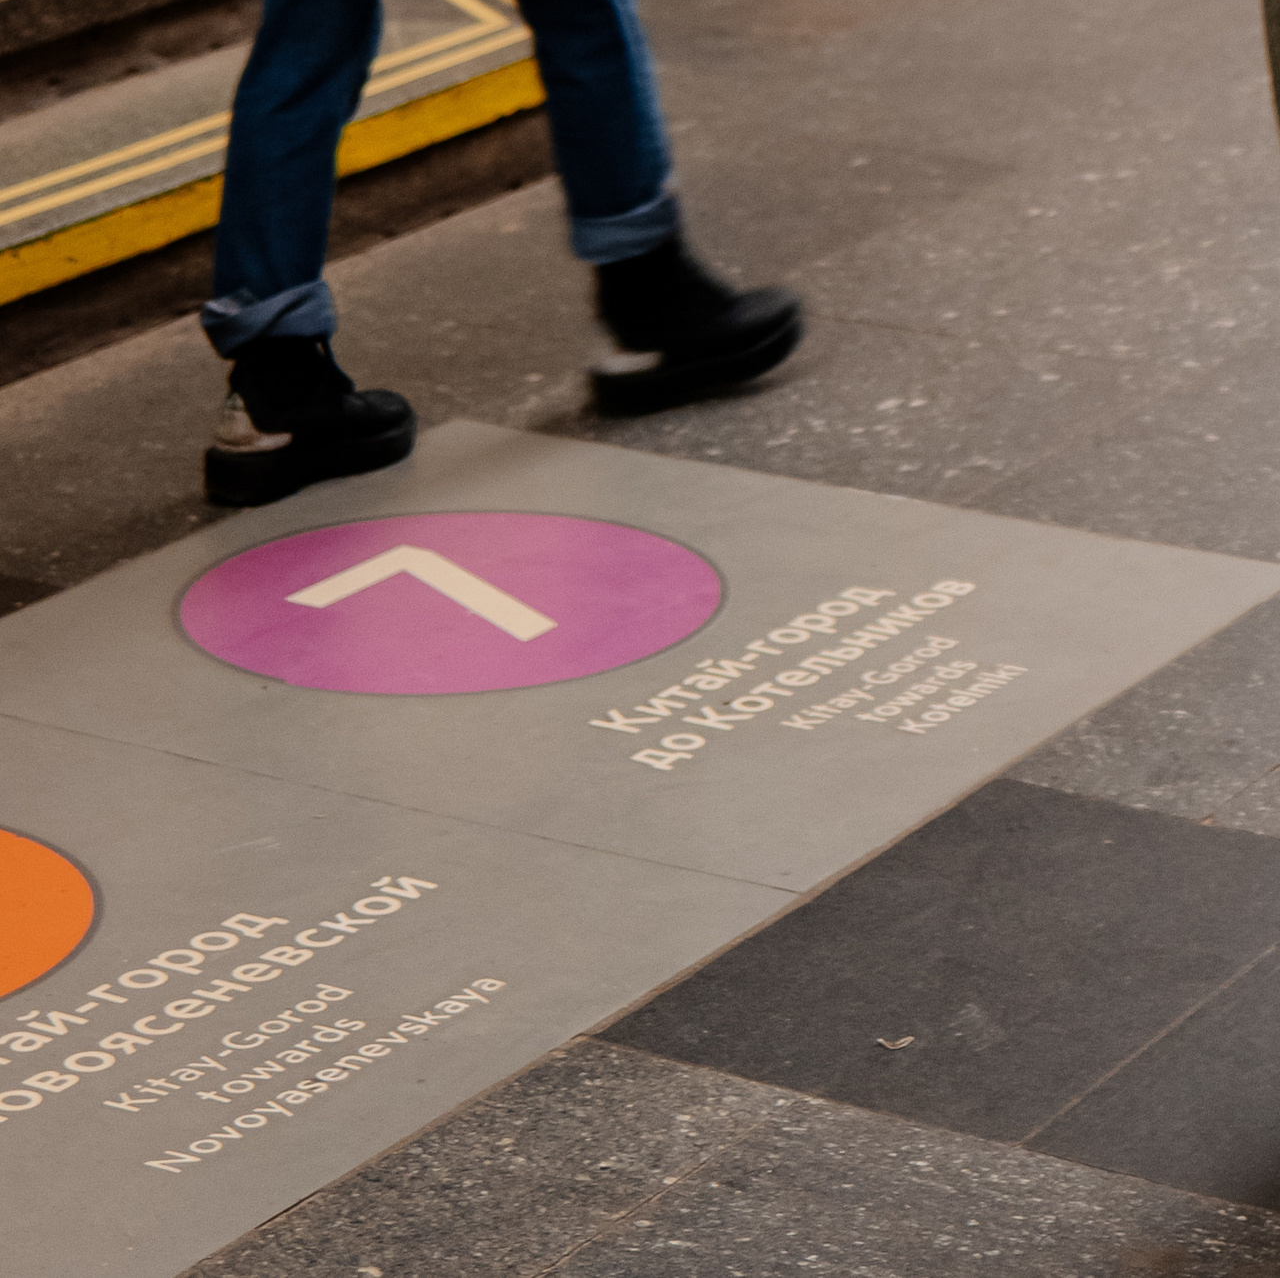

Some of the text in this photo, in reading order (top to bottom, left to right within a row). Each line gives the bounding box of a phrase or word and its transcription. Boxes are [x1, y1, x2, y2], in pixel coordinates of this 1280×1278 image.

[589, 586, 897, 734] Китай-город
[630, 578, 976, 771] до Котельников
[781, 635, 960, 730] Kitay-Gorod
[855, 659, 978, 723] towards
[897, 663, 1030, 735] Kotelniki
[0, 911, 289, 1065] ай-город
[0, 875, 439, 1123] овоясеневской
[102, 983, 355, 1113] Kitay-Gorod
[143, 974, 507, 1174] Novoyasenevskaya
[195, 1015, 367, 1105] towards
